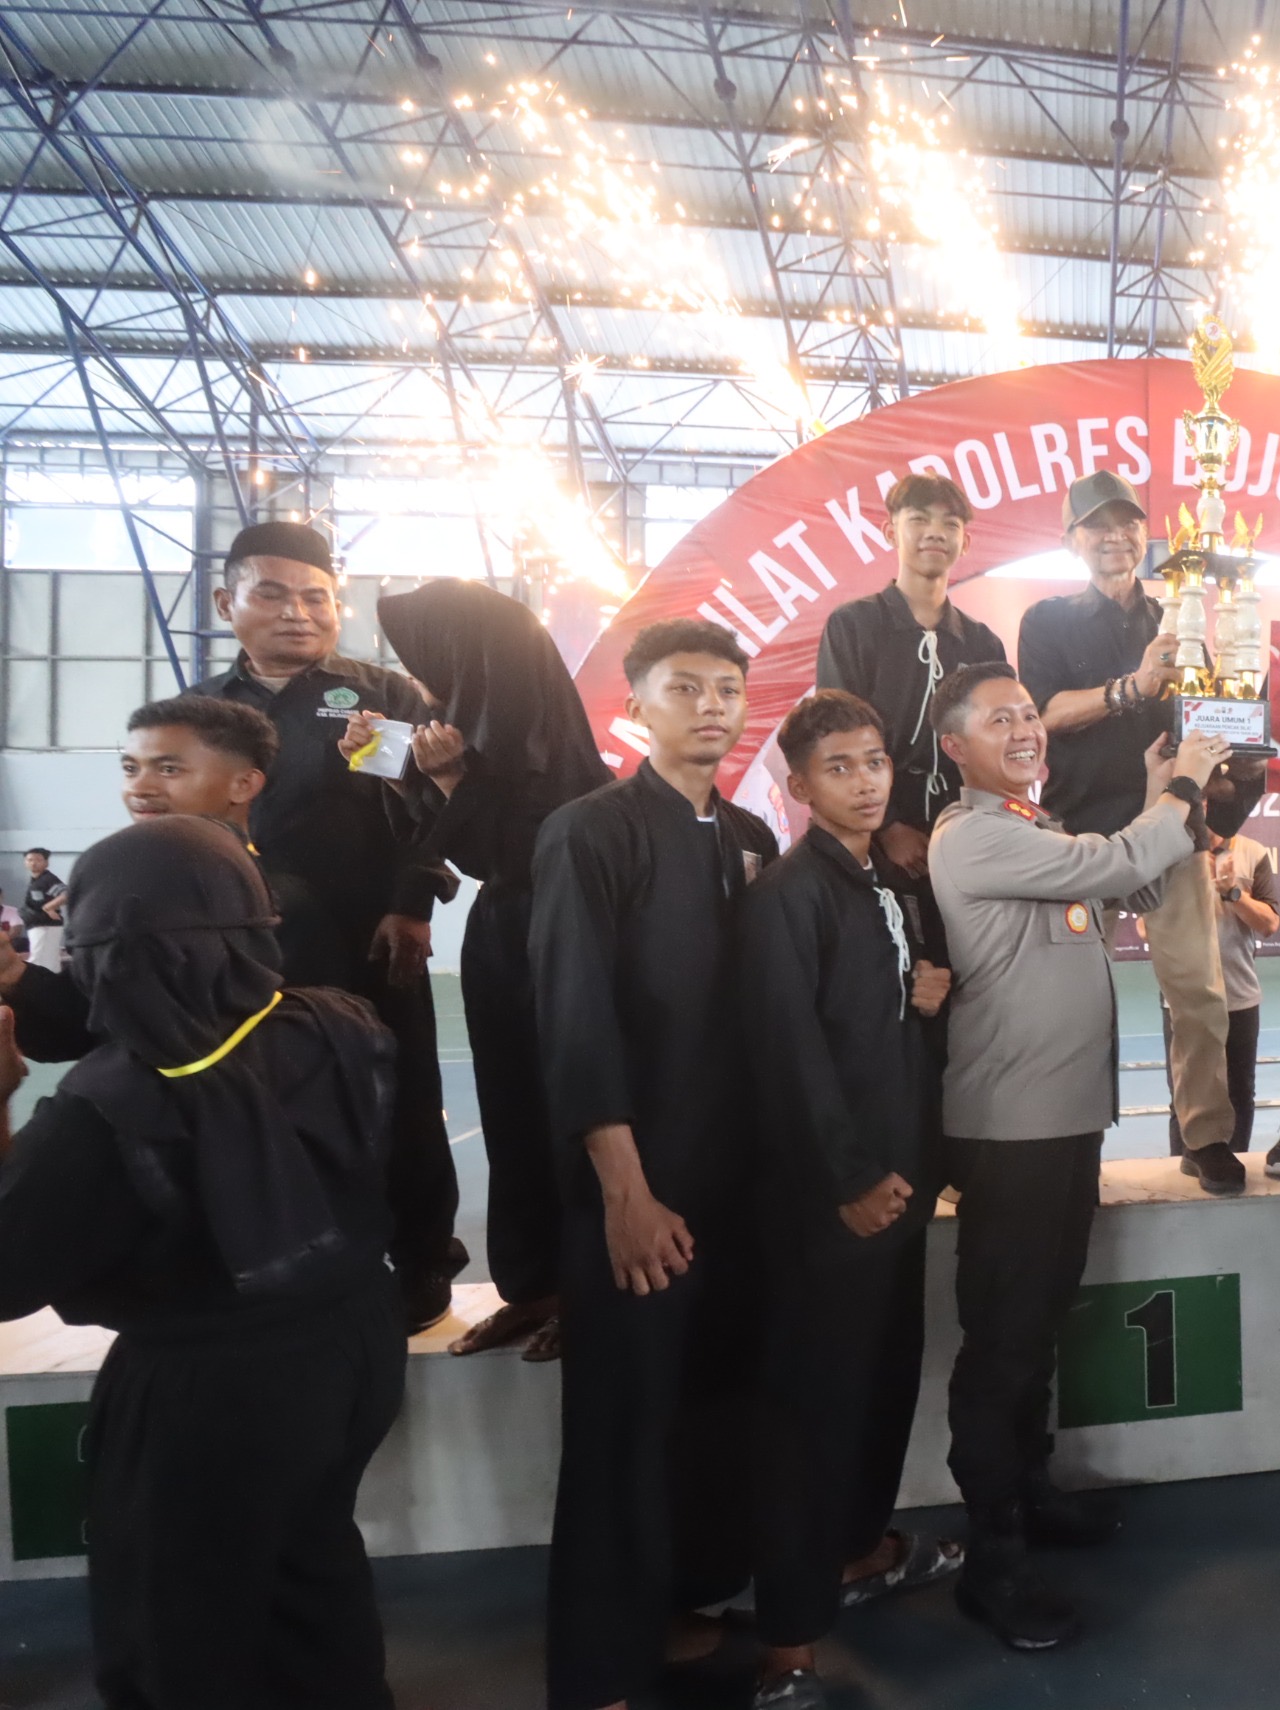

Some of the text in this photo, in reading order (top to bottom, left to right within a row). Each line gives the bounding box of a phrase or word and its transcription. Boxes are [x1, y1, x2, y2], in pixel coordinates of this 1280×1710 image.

[696, 519, 838, 658] ILAT
[824, 416, 1151, 565] KOLRES
[1195, 715, 1220, 723] JUARA
[1222, 716, 1245, 724] UMUM
[1124, 1290, 1177, 1409] 1
